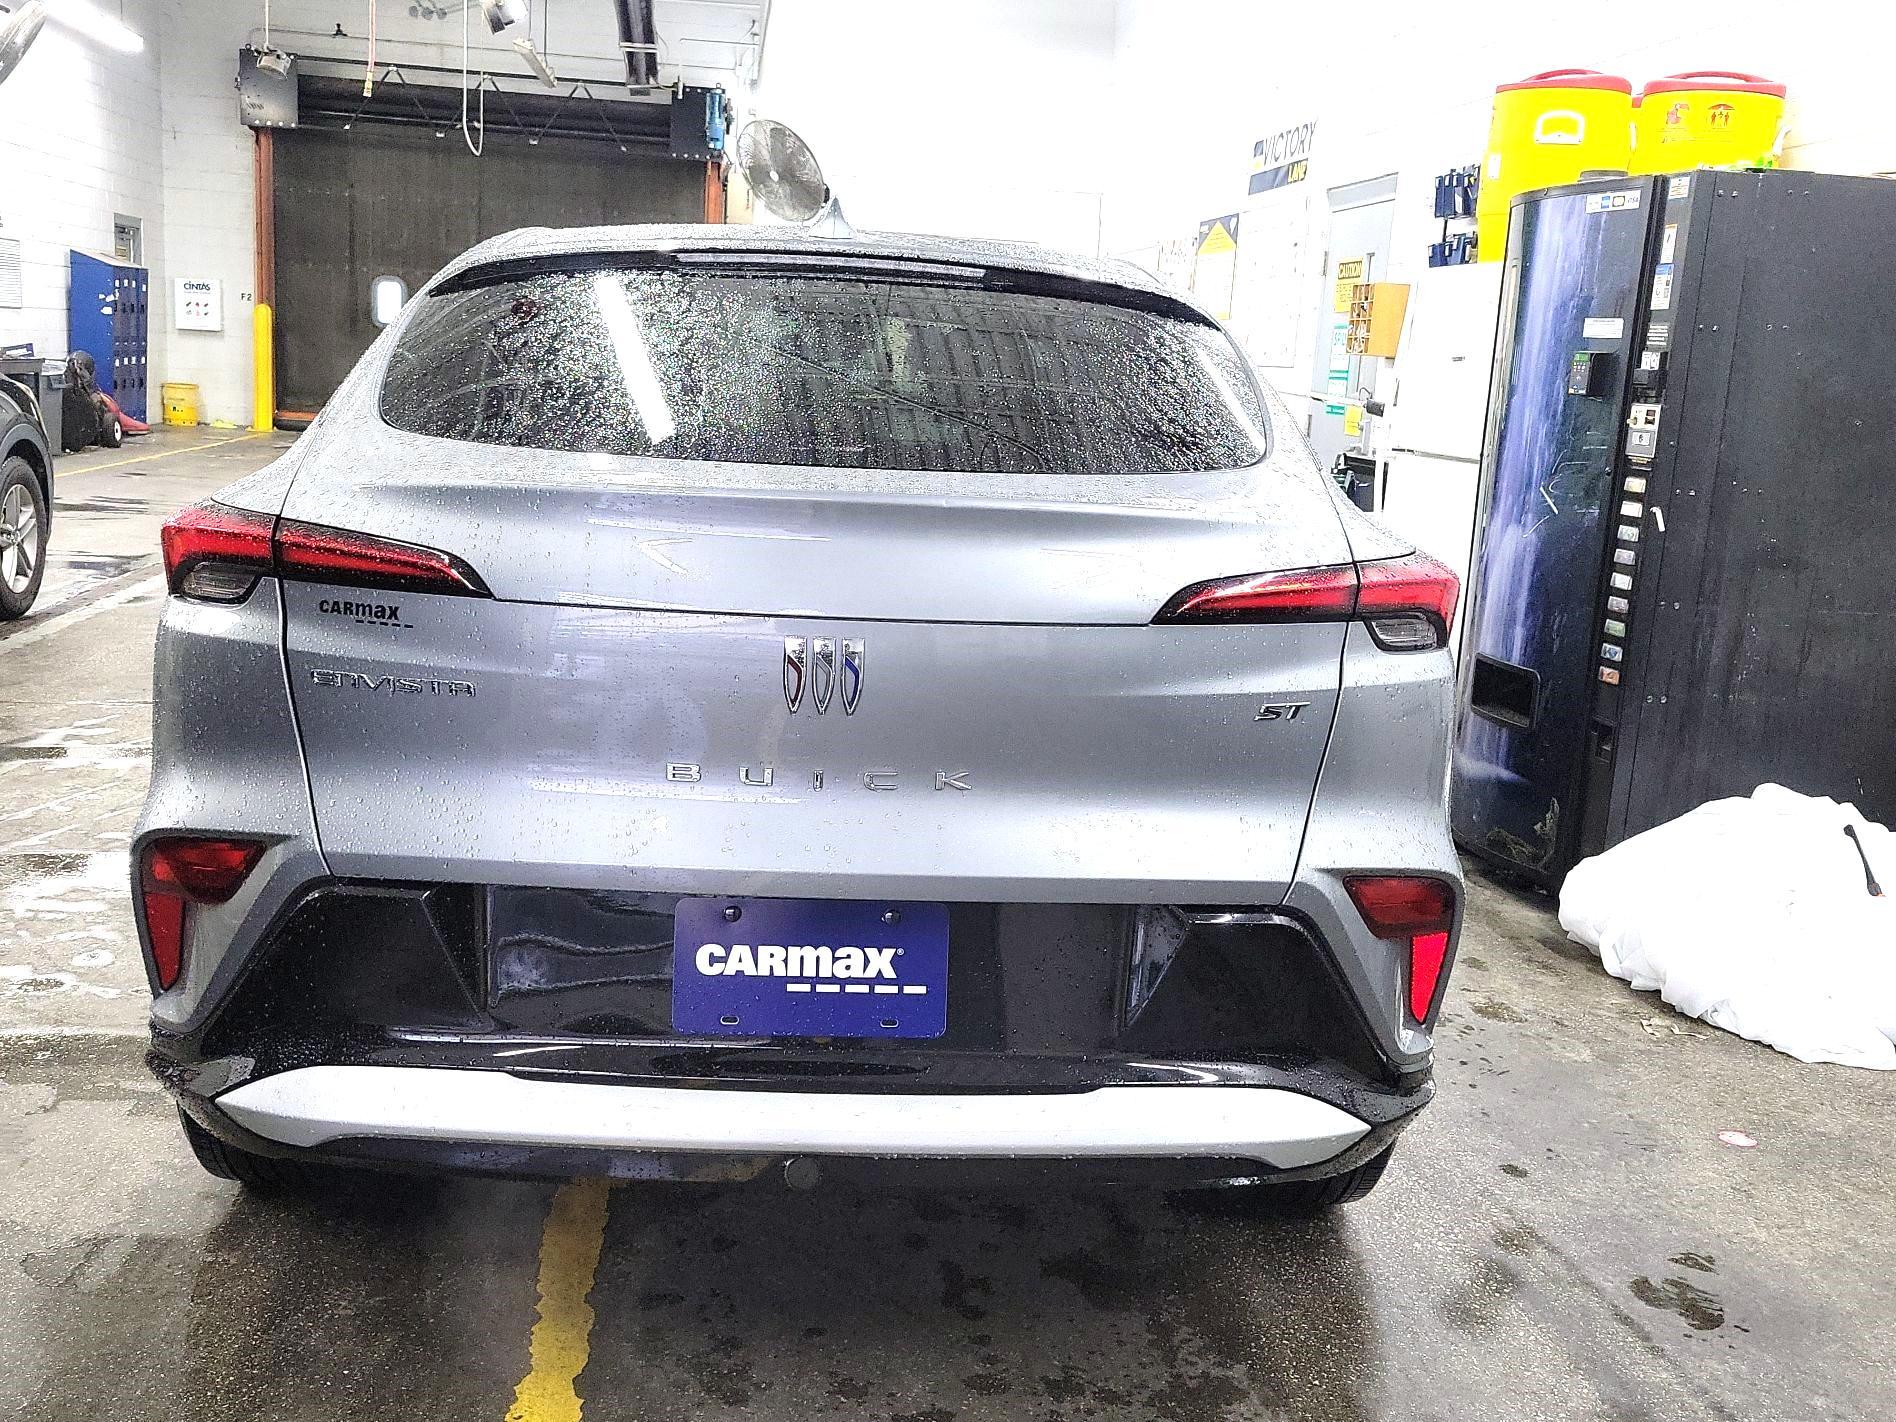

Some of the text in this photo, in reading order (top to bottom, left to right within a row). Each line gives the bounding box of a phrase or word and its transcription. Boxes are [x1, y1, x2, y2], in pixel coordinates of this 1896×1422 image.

[1263, 117, 1319, 166] VICTORY
[1287, 160, 1308, 183] LANE
[1338, 261, 1362, 279] CAUTION
[183, 281, 211, 291] CINTAS
[1254, 701, 1311, 721] ST
[665, 762, 973, 792] BUICK
